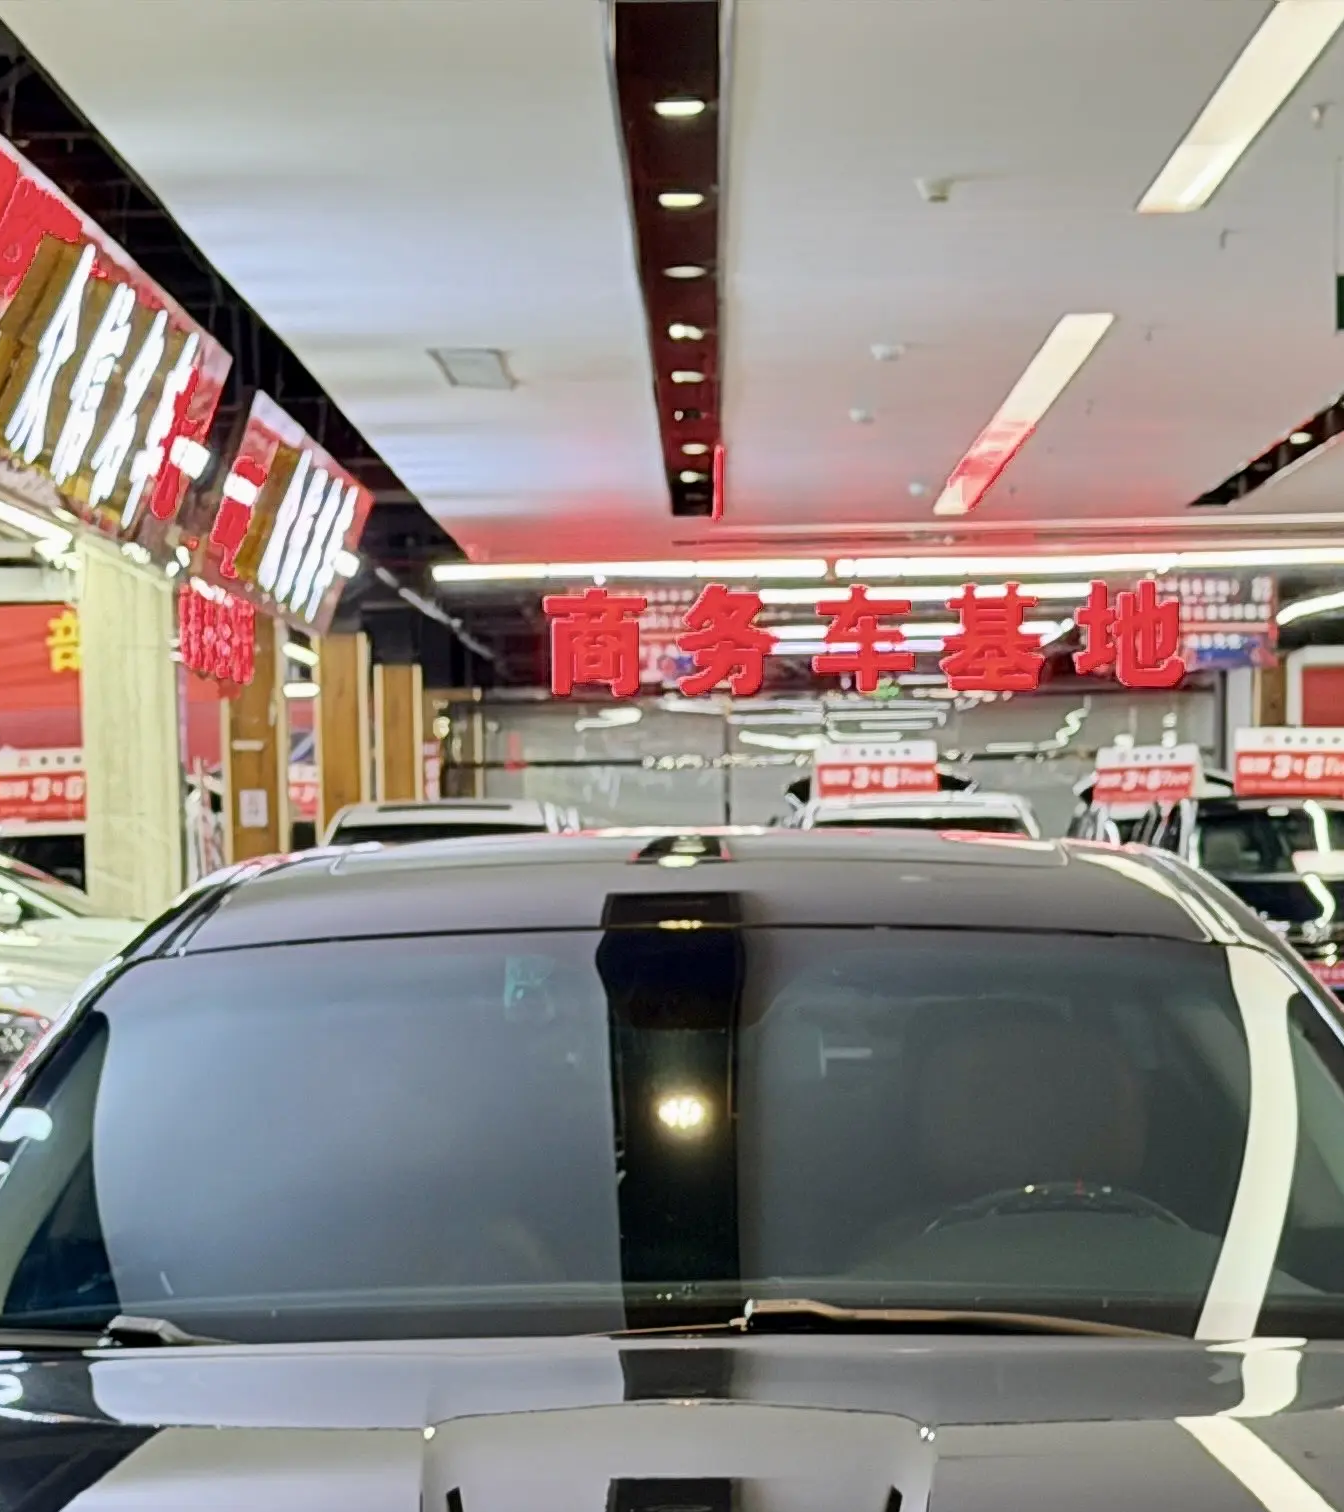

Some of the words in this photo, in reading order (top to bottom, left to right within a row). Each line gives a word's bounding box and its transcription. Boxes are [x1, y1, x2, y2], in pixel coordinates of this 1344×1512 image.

[543, 580, 1186, 698] 商务车基地
